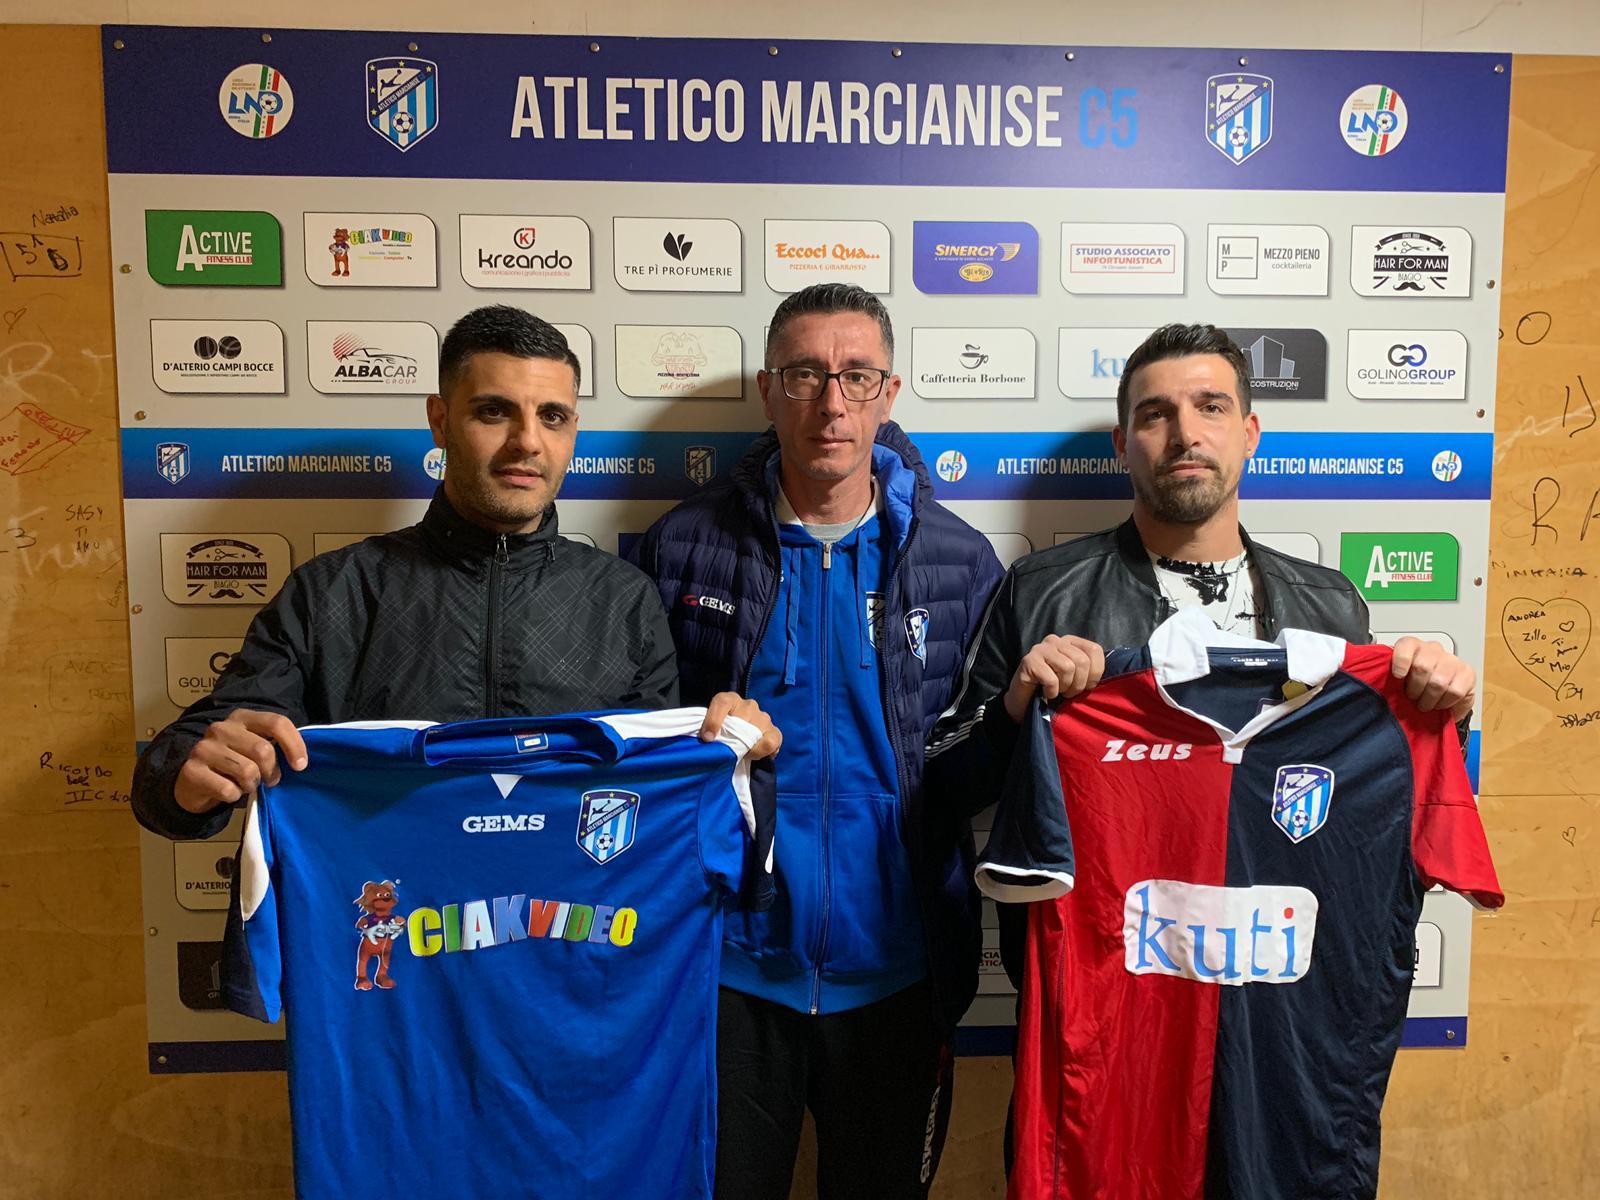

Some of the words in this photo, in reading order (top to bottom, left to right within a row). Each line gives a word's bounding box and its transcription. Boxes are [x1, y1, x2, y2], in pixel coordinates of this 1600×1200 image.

[510, 76, 745, 143] ATLETICO
[761, 80, 1063, 148] MARCIANISE
[1078, 86, 1139, 149] C5
[176, 224, 253, 272] ACTIVE
[775, 242, 828, 259] Eccoci
[935, 243, 998, 257] SINERGY
[1075, 247, 1113, 256] STUDIO
[1114, 248, 1171, 257] ASSOCIATO
[1221, 243, 1231, 256] M
[1263, 248, 1293, 260] MEZZO
[1295, 248, 1321, 260] PIENO
[206, 255, 234, 264] FITNESS
[235, 255, 253, 264] CLUB
[478, 248, 573, 270] kreando
[1083, 257, 1163, 265] INFORTUNISTICA
[1221, 260, 1228, 272] P
[1271, 261, 1312, 270] cocktaileria
[1374, 258, 1396, 269] HAIR
[1398, 257, 1422, 269] FOR
[1424, 258, 1448, 269] MAN
[624, 265, 645, 275] TRE
[662, 265, 733, 277] PROFUMERIE
[212, 362, 242, 372] CAMPI
[244, 362, 274, 372] BOCCE
[1091, 348, 1128, 379] ku
[334, 364, 418, 378] ALBACAR
[920, 373, 977, 383] Caffetteria
[980, 373, 1026, 383] Borbone
[1357, 368, 1456, 380] GOLINOGROUP
[1250, 380, 1299, 388] COSTRUZIONI
[221, 455, 285, 473] ATLETICO
[287, 455, 371, 473] MARCIANISE
[373, 455, 392, 473] C5
[565, 457, 635, 474] ARCIANISE
[638, 457, 656, 474] C5
[997, 457, 1057, 475] ATLETICO
[1060, 457, 1131, 475] MARCIANI
[1247, 457, 1306, 475] ATLETICO
[1309, 457, 1385, 475] MARCIANISE
[1387, 457, 1404, 475] C5
[187, 565, 210, 576] HAIR
[213, 565, 239, 577] FOR
[241, 565, 266, 577] MAN
[1364, 545, 1434, 589] ACTIVE
[1391, 573, 1416, 581] FITNESS
[700, 595, 736, 616] GEMS
[1101, 739, 1193, 763] Zeus
[462, 814, 546, 834] GEMS
[1134, 884, 1299, 980] kuti
